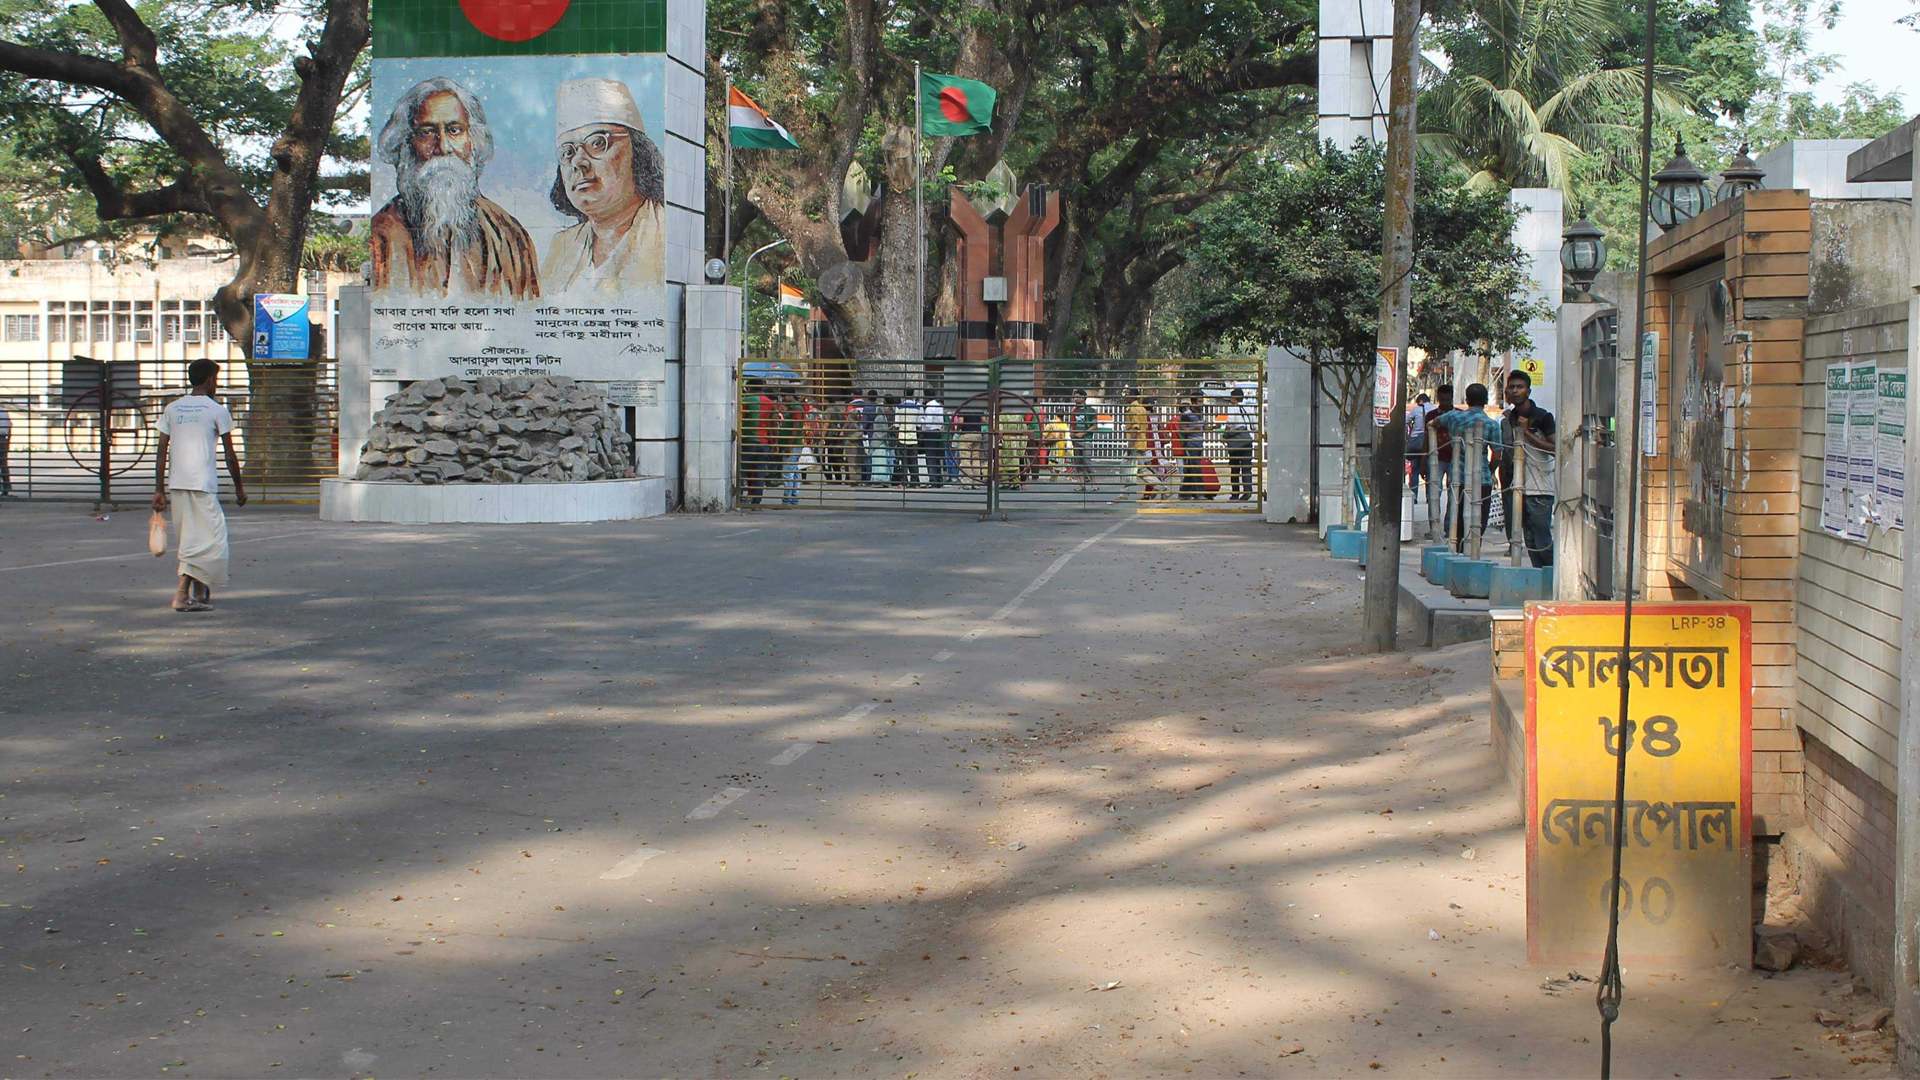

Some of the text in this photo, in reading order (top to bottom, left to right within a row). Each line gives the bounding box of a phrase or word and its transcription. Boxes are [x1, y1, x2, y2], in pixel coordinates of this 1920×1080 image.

[374, 307, 407, 317] আবার
[411, 307, 436, 317] দেখা
[440, 305, 460, 317] যদি
[464, 307, 489, 317] হলো
[535, 306, 560, 316] গাহি
[565, 307, 605, 316] সাম্যের
[392, 322, 426, 332] প্রাণের
[430, 322, 457, 332] মাঝে
[535, 319, 579, 328] মানুষের
[643, 317, 665, 328] নাই
[535, 330, 559, 340] নহে
[448, 354, 562, 367] আশরাফুল আলম লিটন
[1671, 616, 1726, 631] LRP-38
[1539, 645, 1729, 690] কোলকাতা
[1598, 715, 1682, 758] ৮৪
[1541, 798, 1736, 851] বেনাপোল
